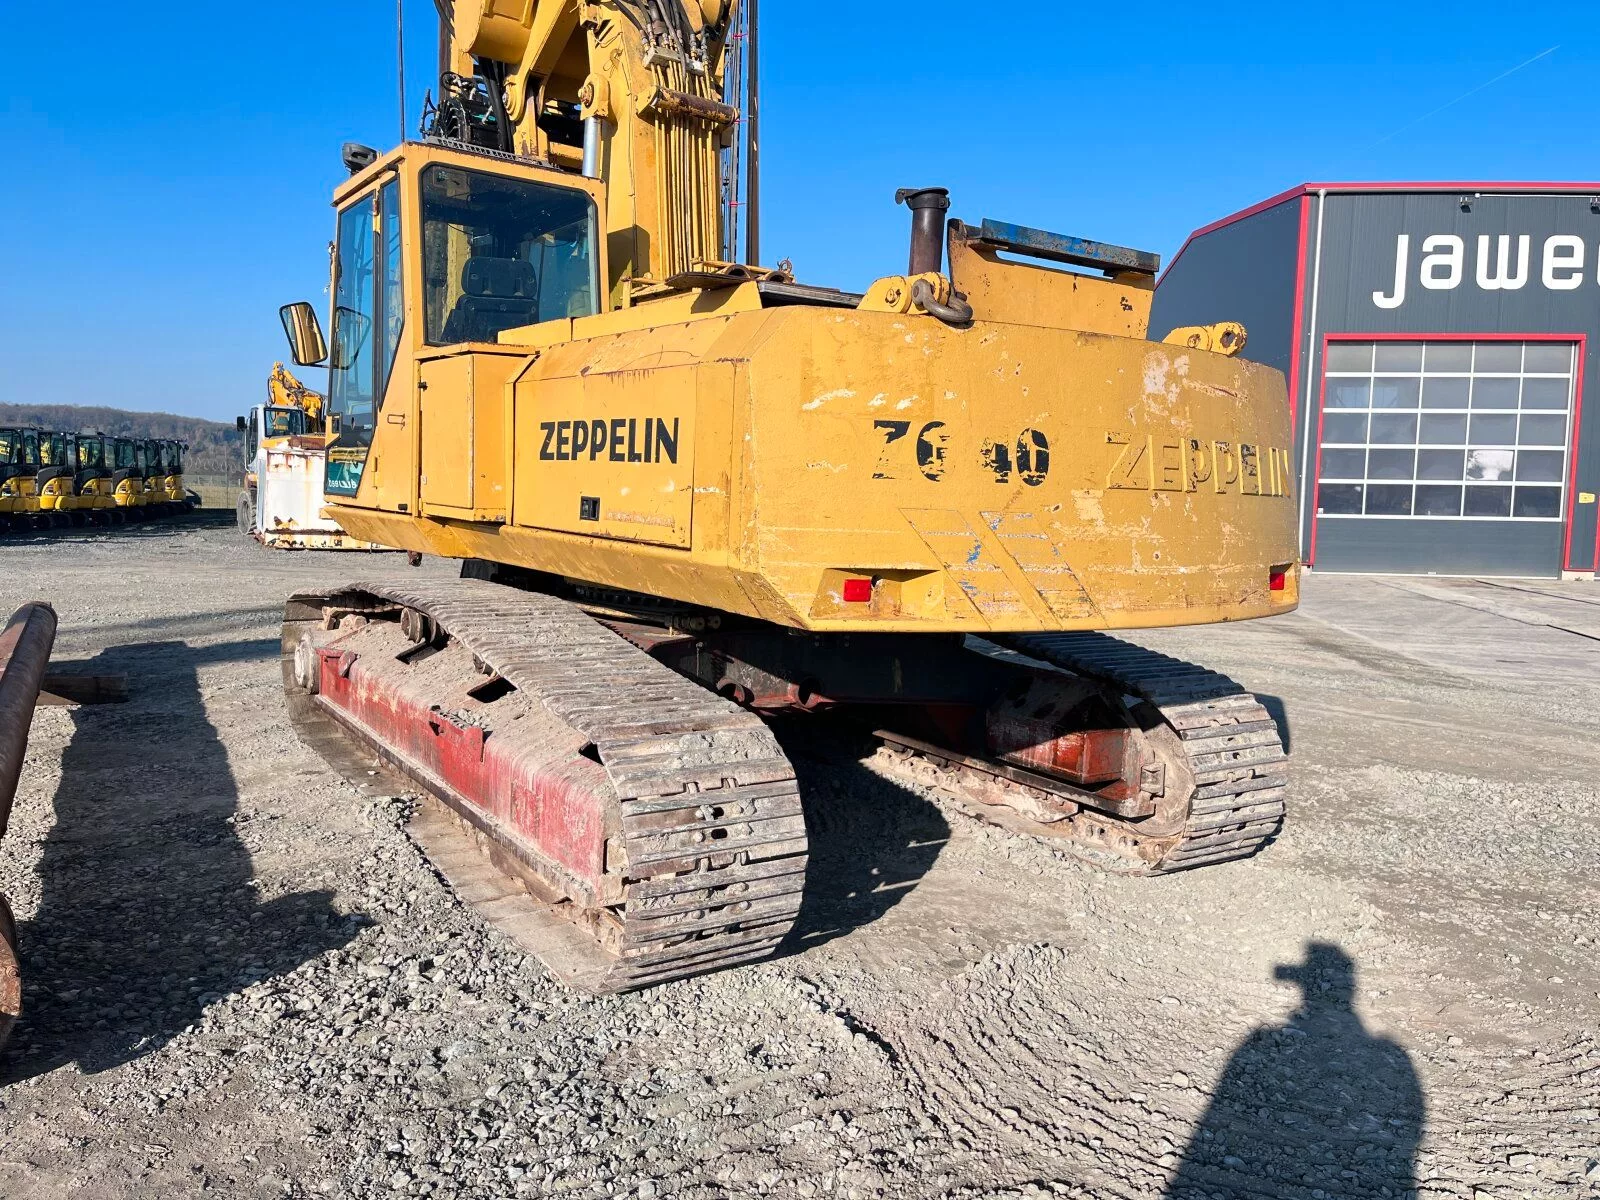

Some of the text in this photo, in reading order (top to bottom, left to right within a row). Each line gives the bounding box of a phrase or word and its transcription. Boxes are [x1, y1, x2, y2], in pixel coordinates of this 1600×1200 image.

[1372, 234, 1600, 309] jawe
[539, 417, 679, 464] ZEPPELIN
[977, 427, 1050, 487] 40
[1104, 431, 1291, 499] ZEPPELIN
